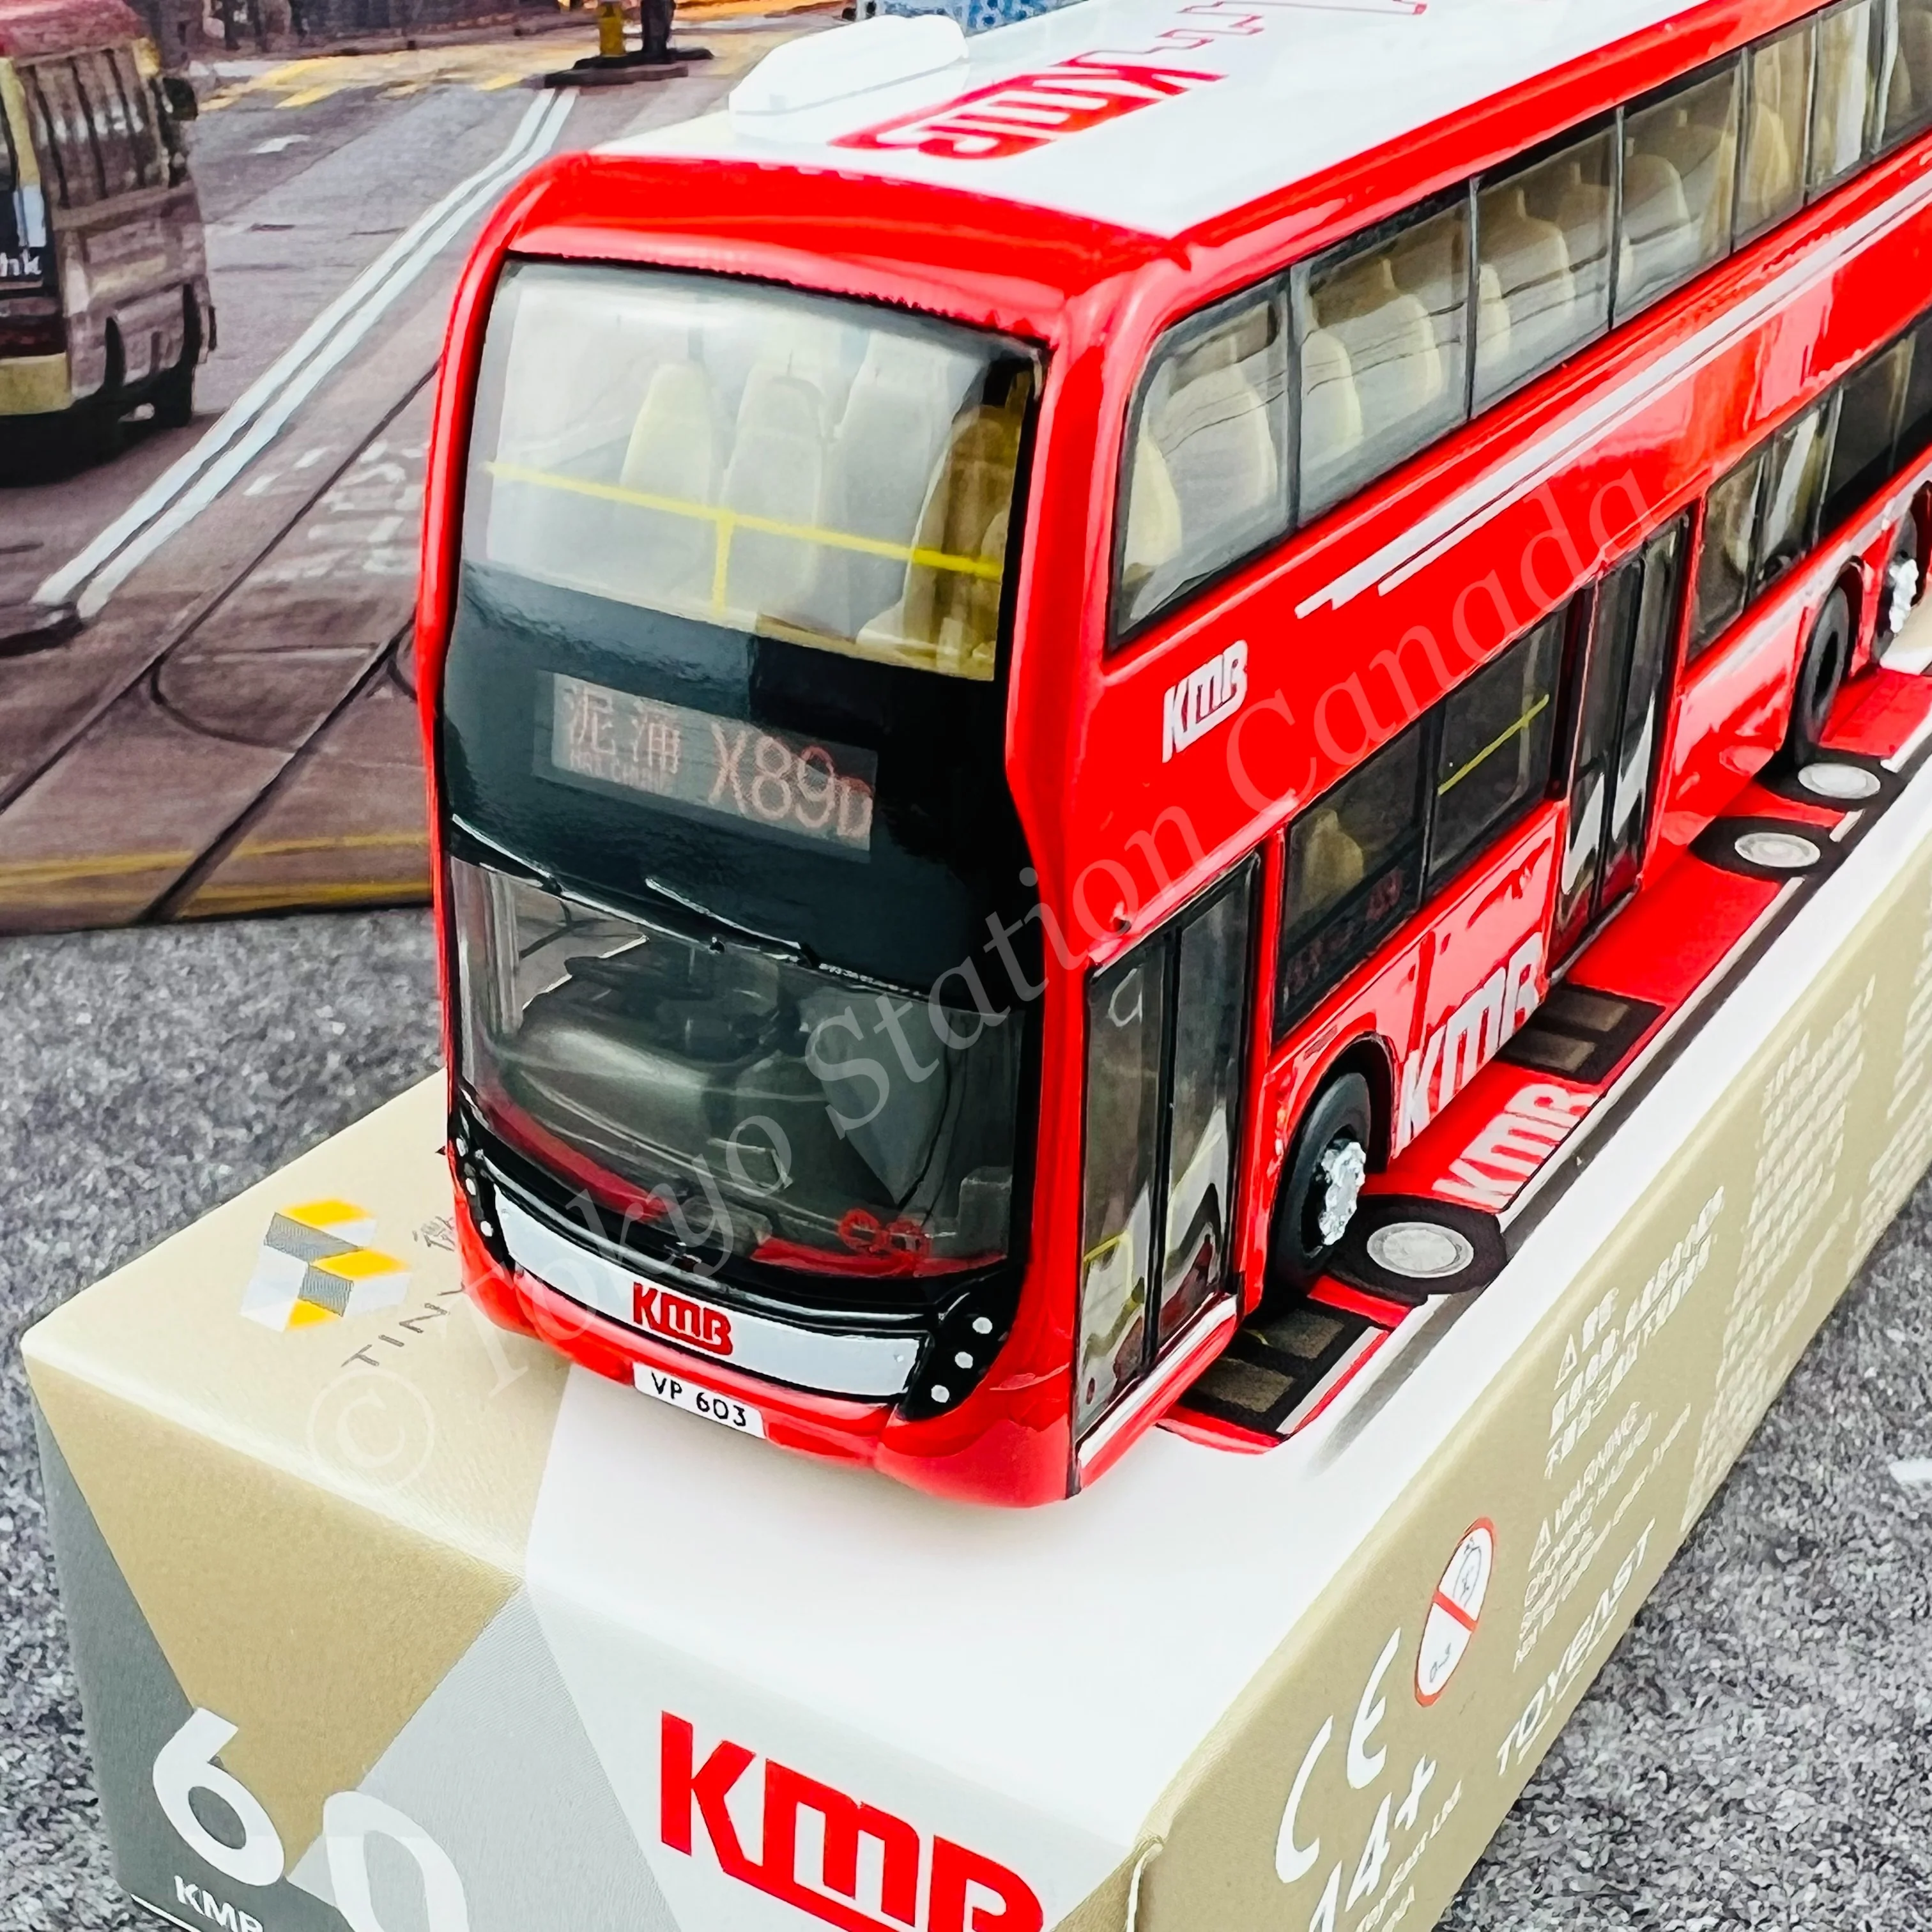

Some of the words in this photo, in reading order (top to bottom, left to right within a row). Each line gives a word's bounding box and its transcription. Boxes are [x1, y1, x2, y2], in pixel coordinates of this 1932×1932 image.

[1162, 640, 1248, 762] KMB
[1392, 931, 1543, 1160] KMB
[633, 1281, 733, 1356] KMB
[651, 1371, 682, 1400] VP
[696, 1392, 746, 1427] 603
